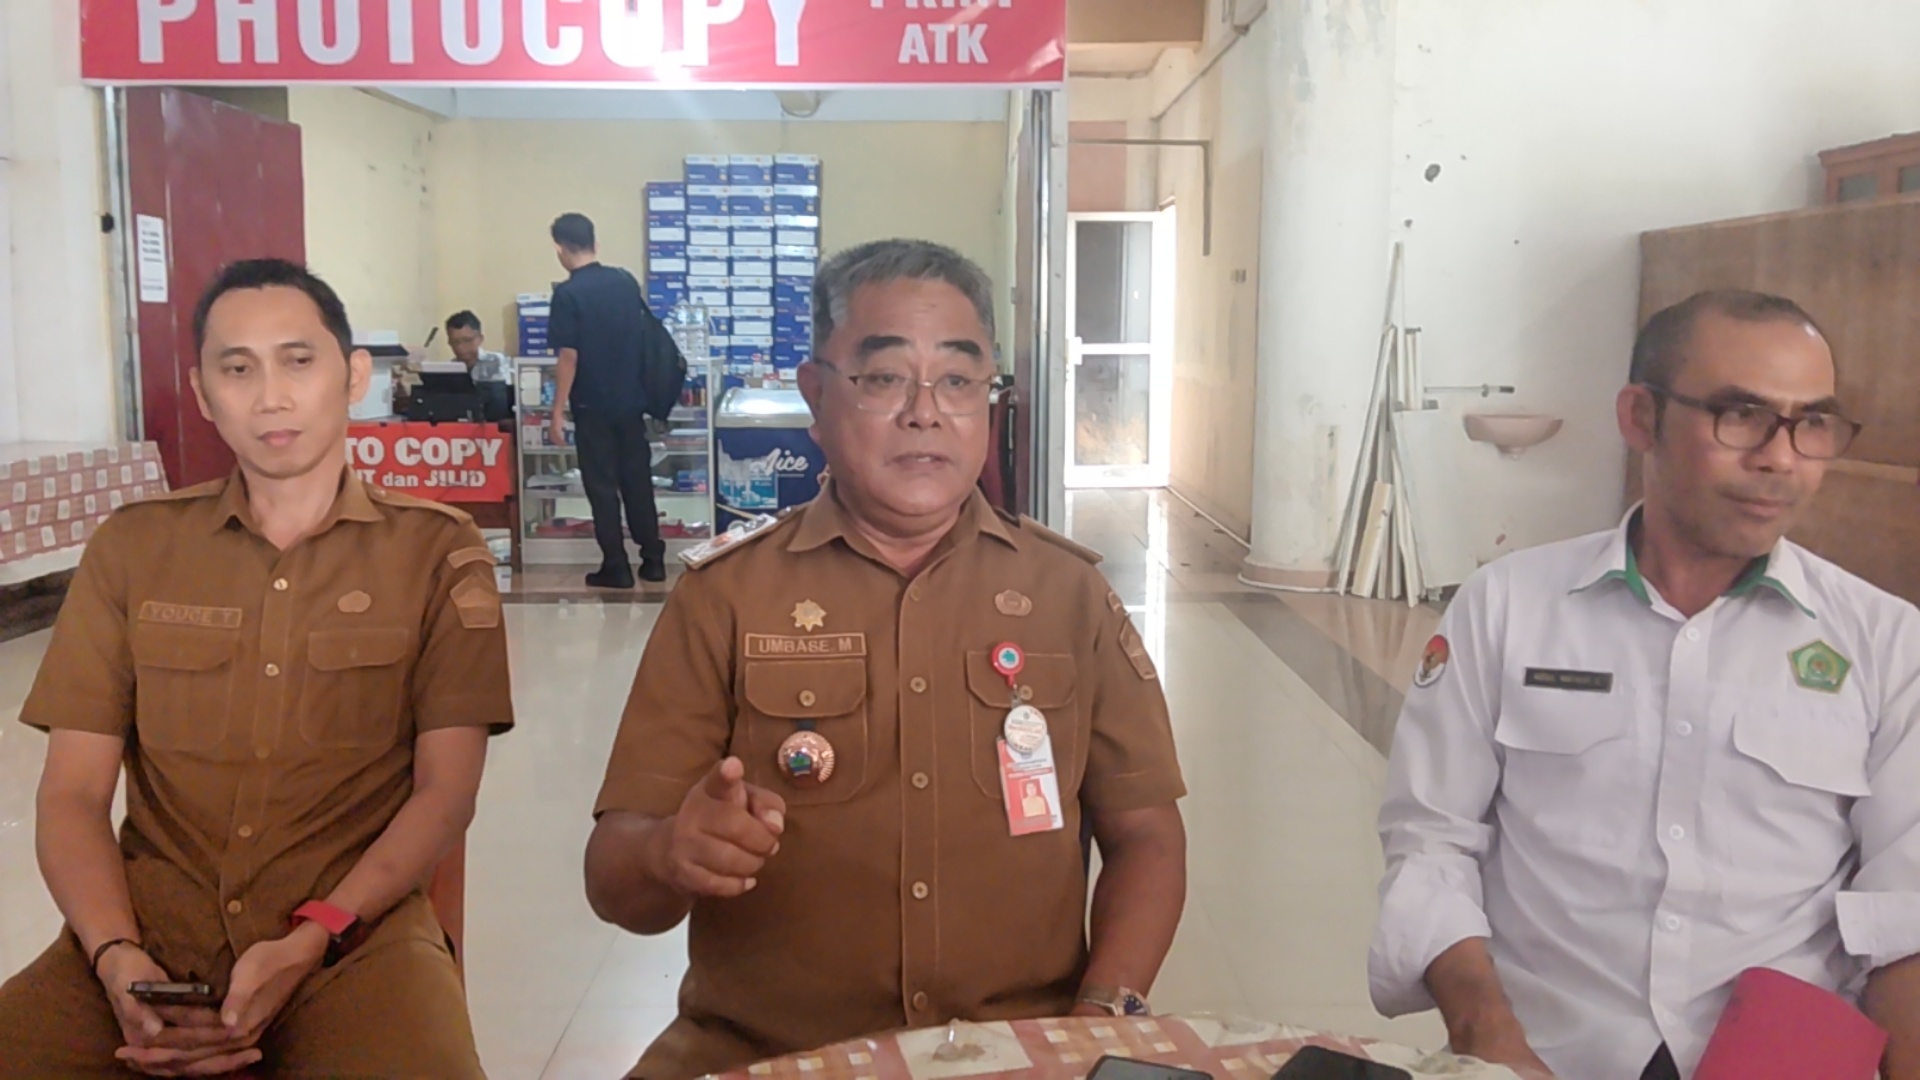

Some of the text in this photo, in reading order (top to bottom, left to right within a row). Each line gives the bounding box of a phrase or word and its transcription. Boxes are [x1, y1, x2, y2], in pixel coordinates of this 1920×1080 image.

[897, 23, 989, 64] ATK
[394, 437, 503, 466] COPY
[765, 448, 808, 476] Aice
[382, 471, 419, 487] dan
[424, 469, 487, 487] JILID
[838, 637, 853, 652] M
